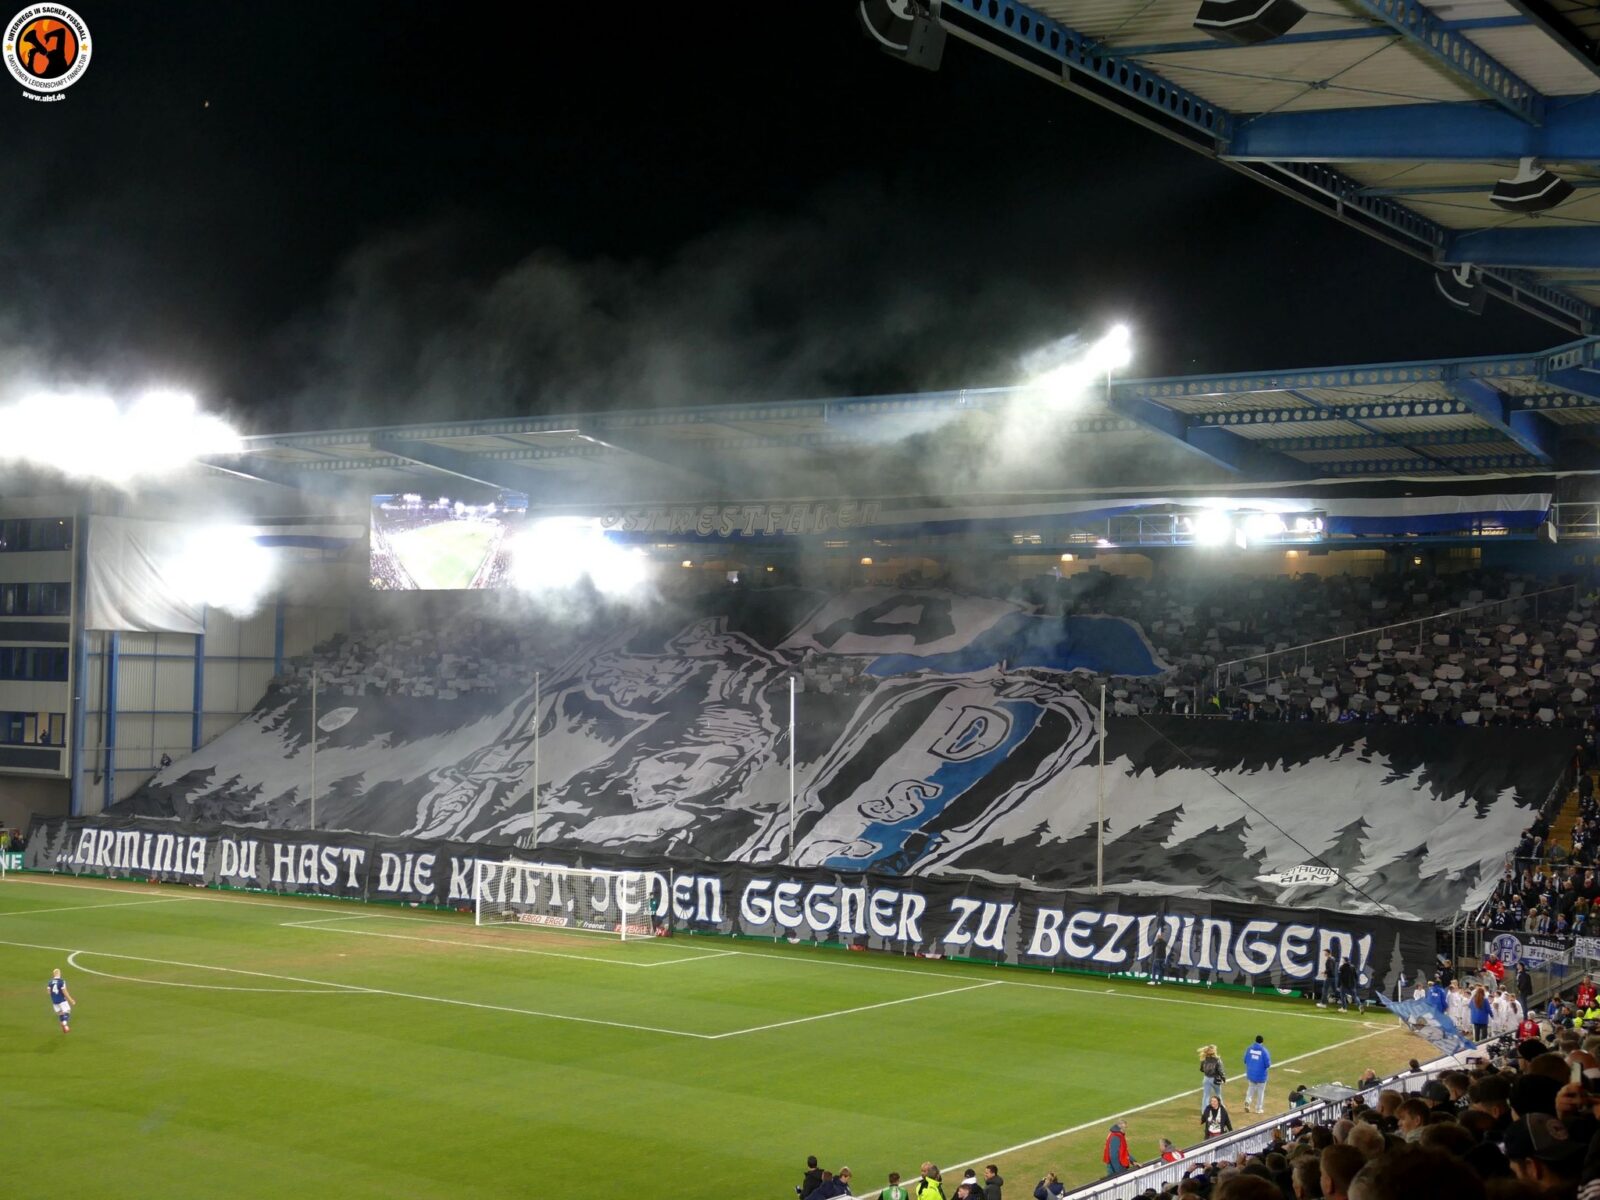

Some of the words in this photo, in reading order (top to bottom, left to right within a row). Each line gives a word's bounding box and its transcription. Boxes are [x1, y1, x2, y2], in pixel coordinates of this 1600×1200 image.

[219, 839, 258, 879] DU
[272, 843, 366, 889] HAST
[377, 852, 437, 896] DIE
[448, 857, 575, 913] KRAFT,
[588, 867, 723, 922] JEDEN
[740, 880, 928, 943] GEGNER
[942, 897, 1016, 950] ZU
[521, 914, 542, 923] ERGO
[544, 917, 565, 926] ERGO
[583, 921, 606, 930] freenet
